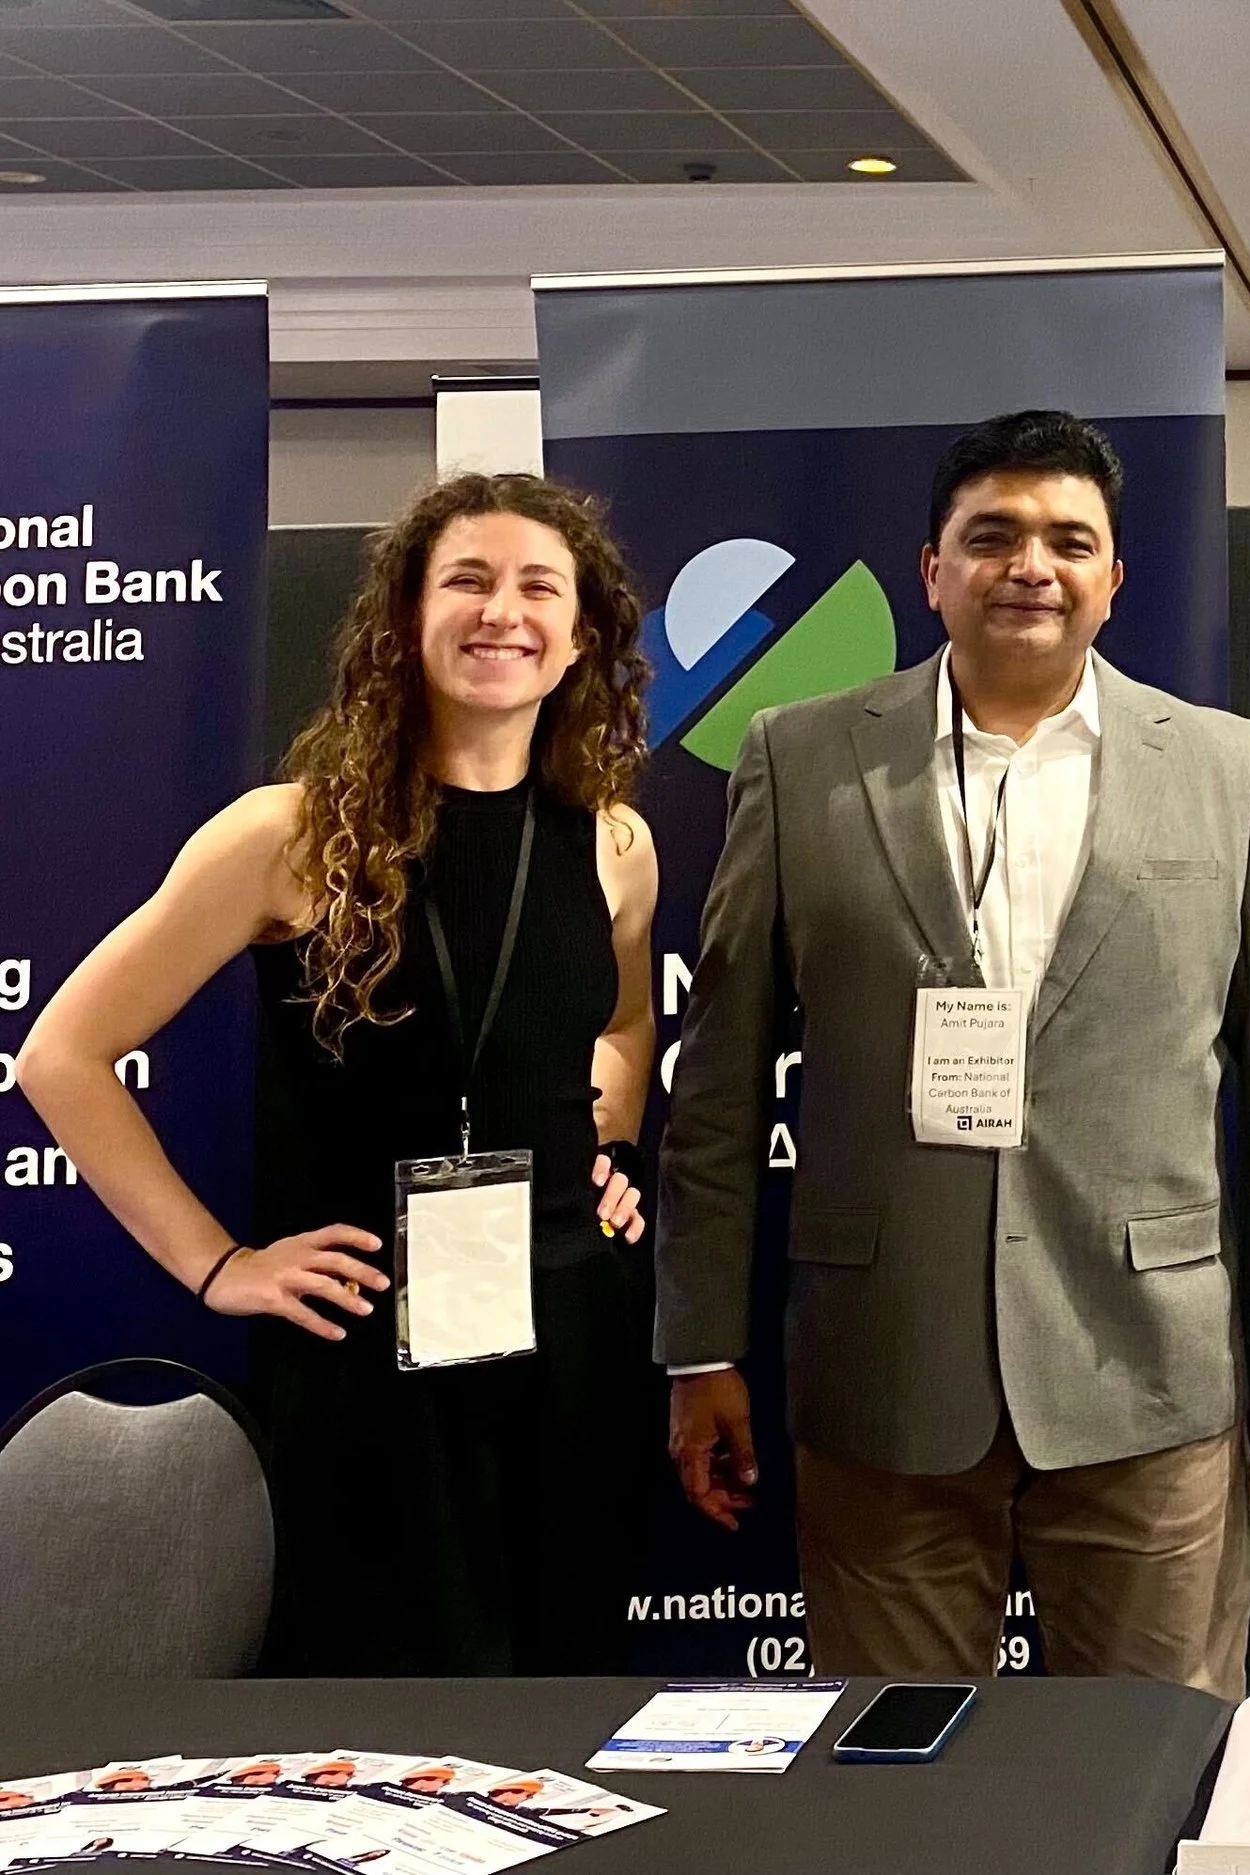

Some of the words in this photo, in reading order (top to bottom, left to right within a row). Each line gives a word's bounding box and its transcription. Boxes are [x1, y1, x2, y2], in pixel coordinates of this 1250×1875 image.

[0, 572, 67, 606] on
[85, 559, 223, 604] Bank
[1, 618, 144, 664] stralia
[936, 1001, 953, 1013] My
[957, 1001, 993, 1011] Name
[997, 1001, 1012, 1011] is:
[941, 1018, 967, 1028] Amit
[970, 1018, 1005, 1030] Pujara
[952, 1058, 965, 1066] an
[968, 1056, 1015, 1065] Exhibitor
[931, 1073, 962, 1082] From:
[964, 1073, 1009, 1082] National
[928, 1088, 968, 1098] Carbon
[971, 1088, 997, 1098] Bank
[1000, 1088, 1011, 1098] of
[945, 1104, 992, 1114] Australia
[976, 1119, 1012, 1128] AIRAH
